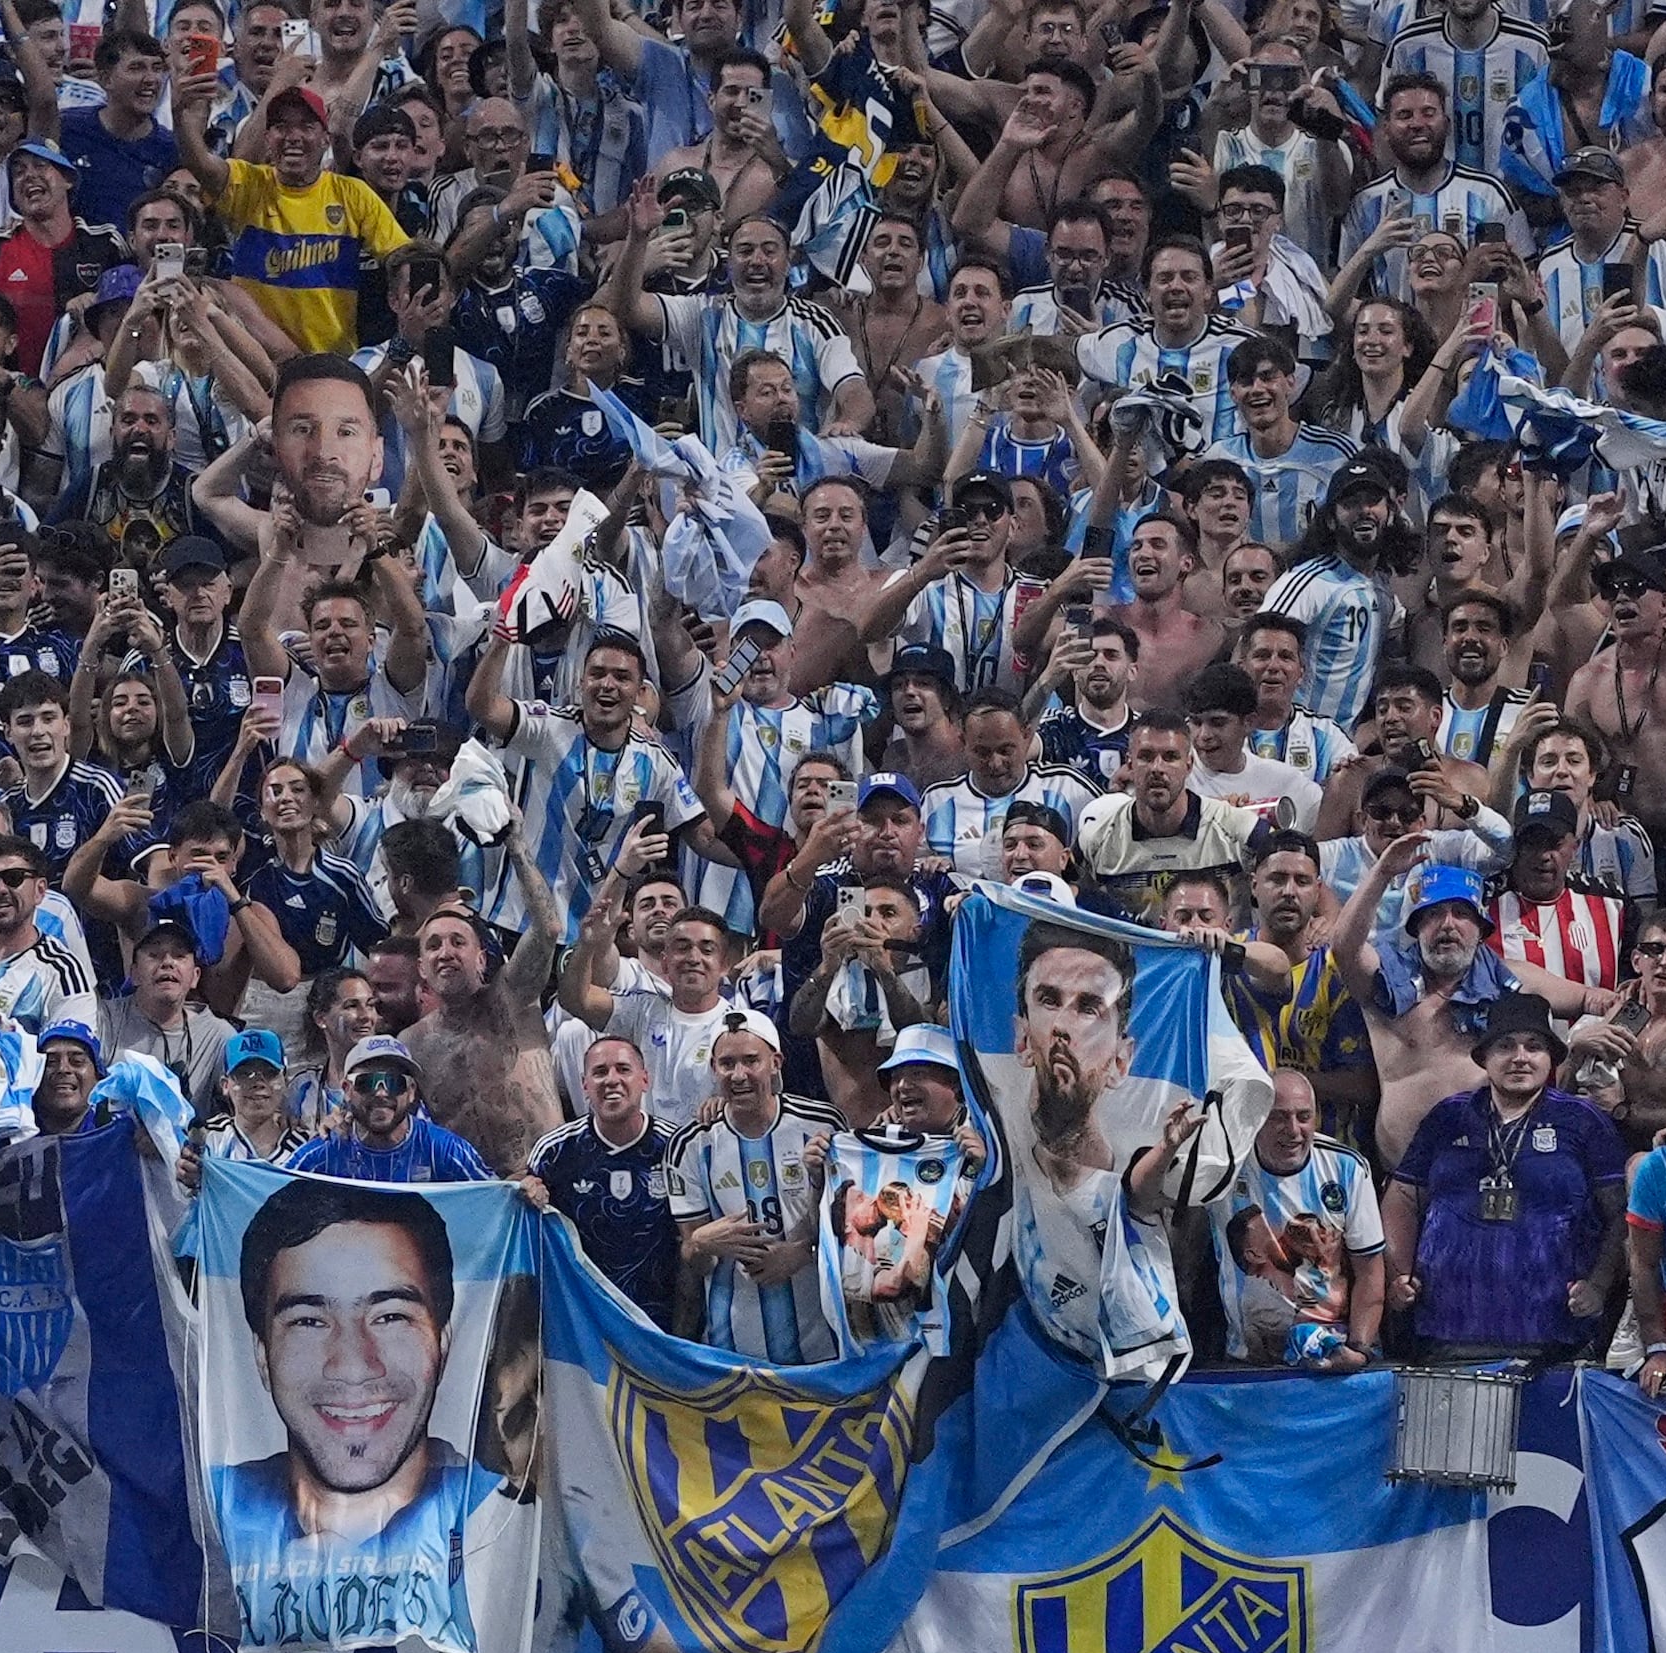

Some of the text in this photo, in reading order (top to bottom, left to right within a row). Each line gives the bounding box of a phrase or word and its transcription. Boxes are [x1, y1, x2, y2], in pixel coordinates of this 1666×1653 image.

[264, 239, 340, 278] Quilmes
[1051, 1284, 1089, 1309] adidas
[686, 1408, 886, 1591] ATLANTA
